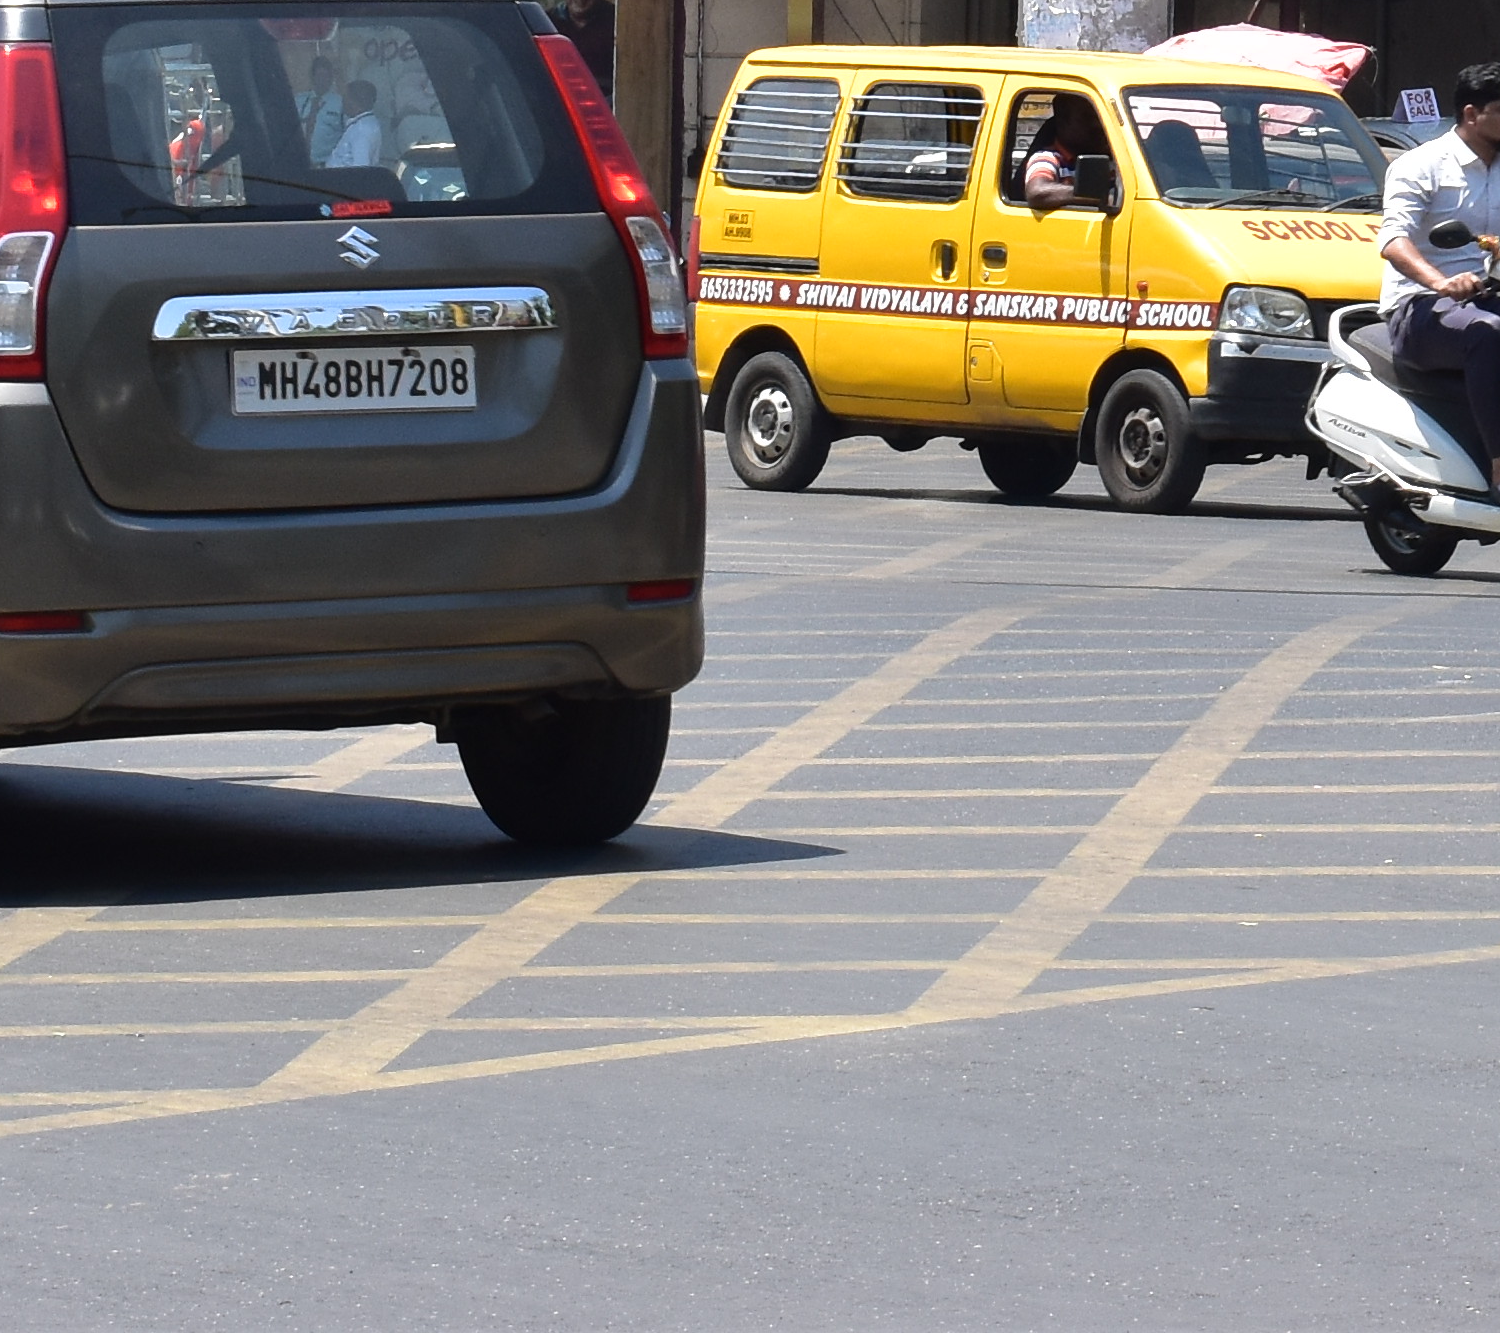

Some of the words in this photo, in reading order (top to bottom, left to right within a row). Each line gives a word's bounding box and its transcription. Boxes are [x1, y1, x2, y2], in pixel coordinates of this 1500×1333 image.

[1406, 89, 1434, 106] FOR
[1409, 104, 1437, 119] SALE
[1241, 220, 1375, 243] SCHOOL
[700, 277, 774, 303] 8652332595
[796, 282, 857, 309] SHIVAI
[860, 285, 954, 315] VIDYALAYA
[955, 292, 969, 315] &
[972, 291, 1060, 321] SANSKAR
[1062, 297, 1131, 324] PUBLIC
[1134, 301, 1214, 329] SCHOOL
[258, 358, 469, 400] MH48BH7208
[1328, 418, 1367, 438] Activa
